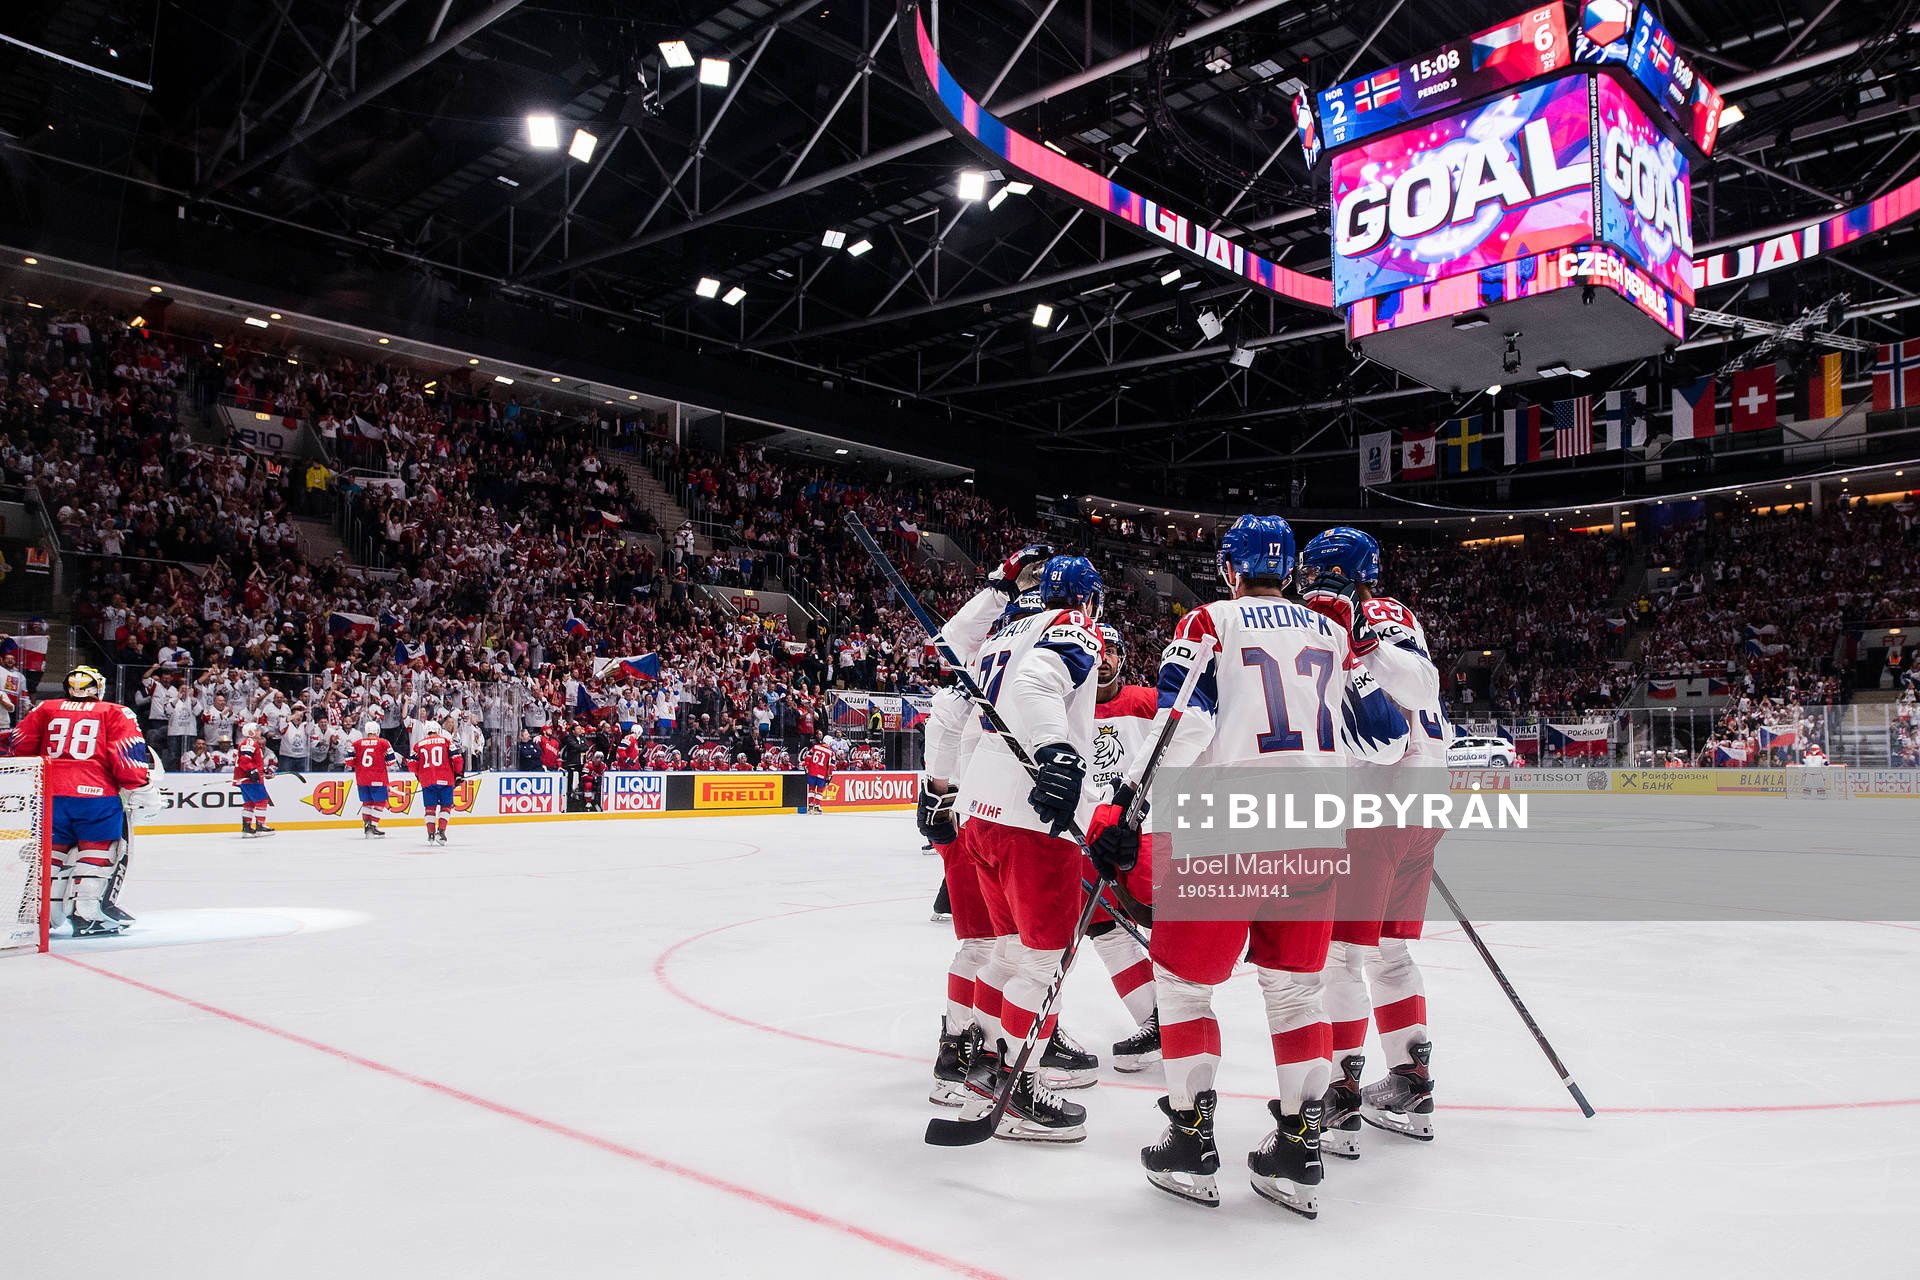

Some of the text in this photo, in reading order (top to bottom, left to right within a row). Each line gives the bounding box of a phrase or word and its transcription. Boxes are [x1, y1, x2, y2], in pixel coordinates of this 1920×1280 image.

[1532, 9, 1552, 23] CZE
[1534, 23, 1555, 52] 6
[1636, 26, 1650, 55] 2
[1409, 49, 1461, 83] 15:08
[1325, 88, 1343, 101] NOR
[1417, 78, 1458, 100] PERIOD 3
[1330, 100, 1348, 126] 2
[1706, 110, 1717, 134] 6
[1336, 117, 1592, 258] GOAL
[1603, 126, 1694, 258] GOAL
[1558, 251, 1668, 320] CZECH REPUBLIC
[1268, 542, 1281, 557] 17
[1051, 570, 1062, 581] 81
[1069, 609, 1098, 637] 81
[1239, 604, 1333, 637] HRONEK
[1051, 627, 1099, 653] ŠKOD
[59, 700, 96, 712] HOLM
[1240, 645, 1336, 754] 17
[46, 717, 101, 761] 38
[1509, 725, 1537, 735] HORKA
[361, 747, 375, 768] 6
[420, 746, 443, 768] 10
[812, 750, 826, 767] 61
[1447, 754, 1478, 762] KODIAQ
[501, 778, 551, 795] LIQUI
[616, 777, 660, 794] LIQUI
[1533, 773, 1582, 782] TISSOT
[1642, 781, 1674, 791] БАНК
[1875, 782, 1912, 793] MOLY
[159, 787, 275, 809] ŠKOD
[615, 793, 661, 811] MOLY
[702, 781, 776, 802] PIRELLI
[500, 795, 552, 813] MOLY
[976, 802, 1002, 819] IIHF
[1376, 1092, 1394, 1102] CCM
